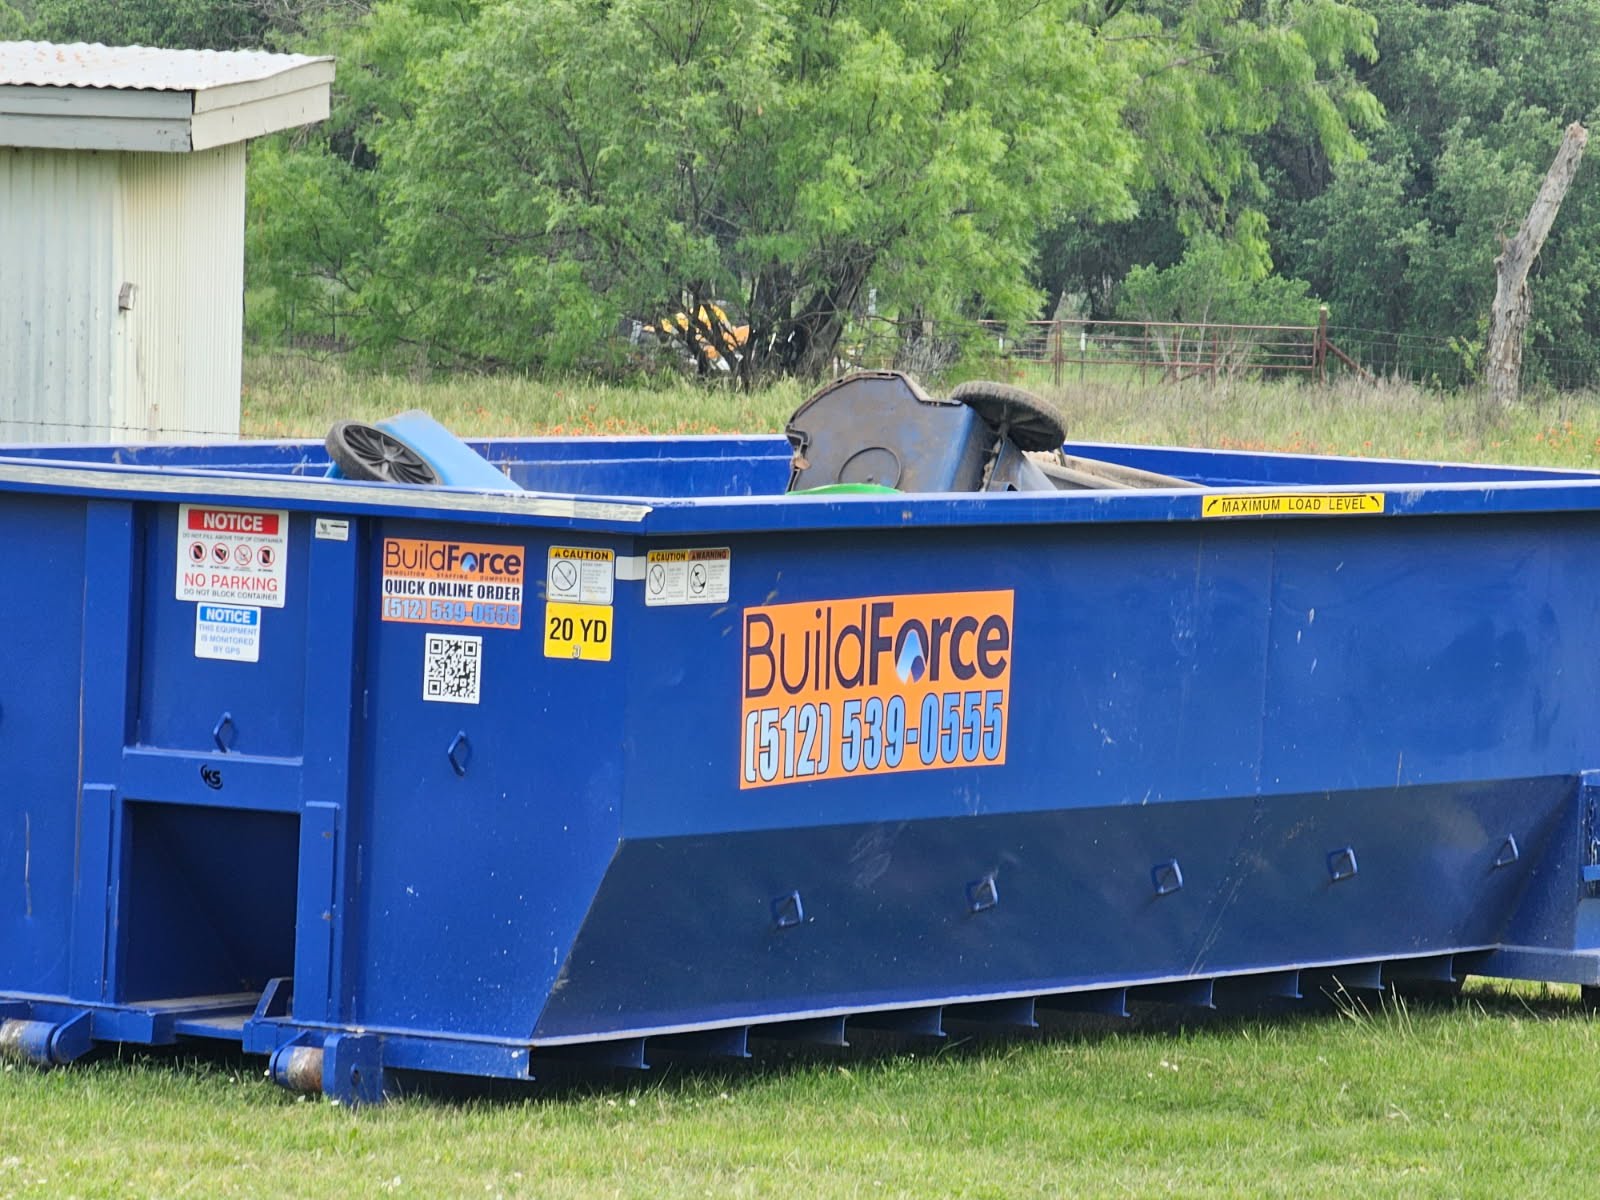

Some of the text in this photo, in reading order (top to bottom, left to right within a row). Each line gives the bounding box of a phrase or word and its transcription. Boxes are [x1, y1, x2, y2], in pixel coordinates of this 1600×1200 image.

[1221, 498, 1366, 513] MAXIMUM LOAD LEVEL
[203, 512, 263, 532] NOTICE
[385, 541, 521, 575] BuildForce
[563, 550, 609, 561] CAUTION
[656, 552, 685, 561] CAUTION
[696, 550, 727, 560] WARNING
[184, 572, 278, 592] NO PARKING
[385, 579, 520, 601] QUICK ONLINE ORDER
[212, 590, 235, 598] BLOCK
[237, 592, 278, 600] CONTAINER
[206, 607, 251, 624] NOTICE
[383, 597, 519, 625] (512) 539-0555
[199, 624, 257, 636] THIS EQUIPMENT
[550, 617, 607, 643] 20 YD
[209, 635, 254, 645] MONITORED
[225, 646, 241, 655] GPS
[745, 601, 1009, 698] BuildForce
[744, 689, 1003, 782] (512) 539-0555
[204, 769, 221, 785] KS
